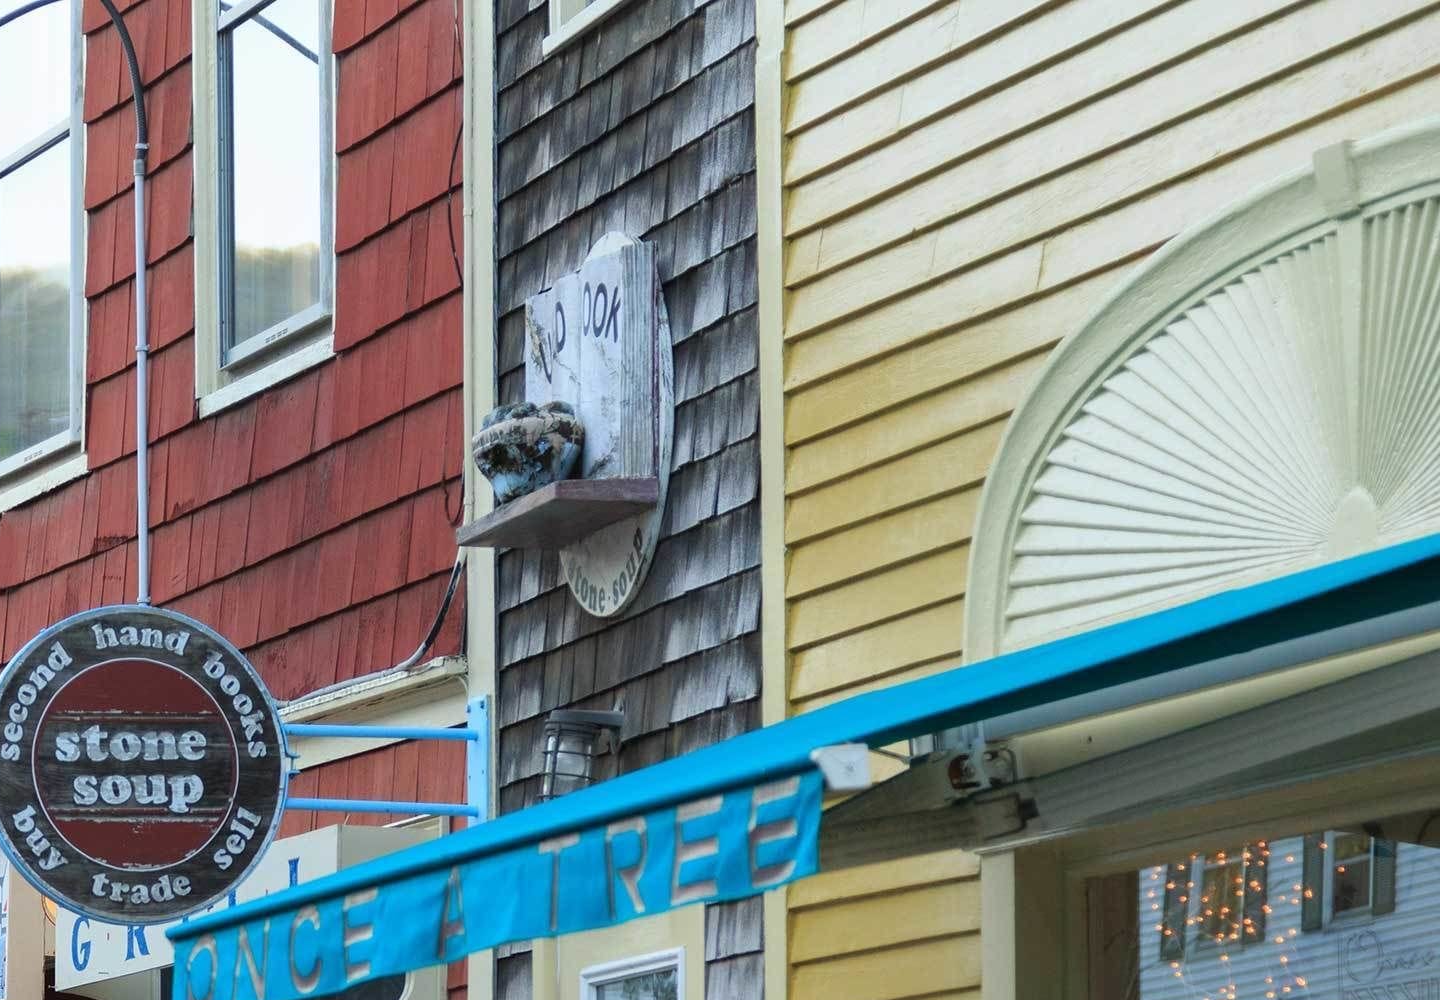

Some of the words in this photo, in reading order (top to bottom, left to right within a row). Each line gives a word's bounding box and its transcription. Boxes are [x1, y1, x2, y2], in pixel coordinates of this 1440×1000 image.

[0, 640, 73, 762] second
[91, 622, 191, 656] hand
[202, 651, 267, 759] books
[54, 724, 208, 763] stone
[72, 773, 205, 814] soup
[12, 804, 70, 872] buy
[91, 872, 192, 905] trade
[213, 806, 262, 871] sell
[438, 868, 468, 958] A
[538, 774, 803, 934] TREE
